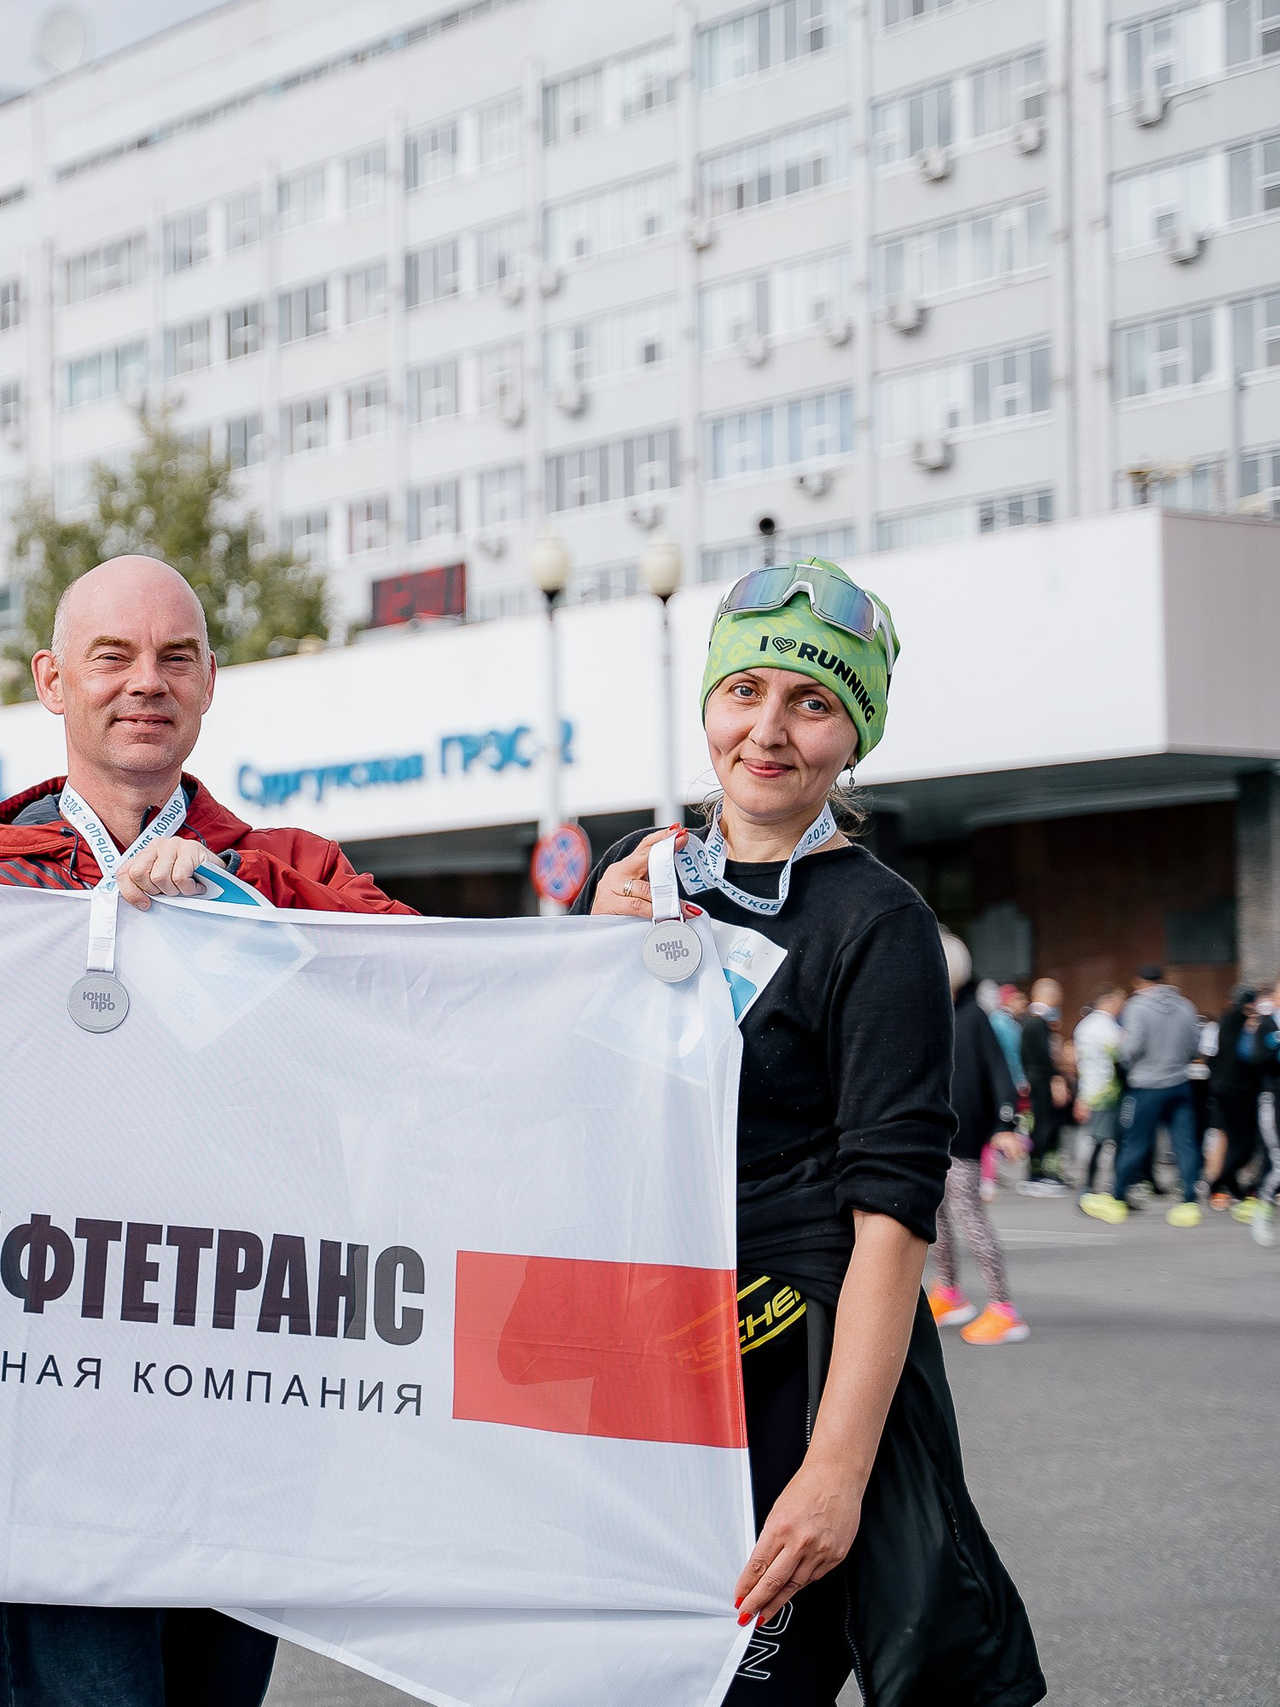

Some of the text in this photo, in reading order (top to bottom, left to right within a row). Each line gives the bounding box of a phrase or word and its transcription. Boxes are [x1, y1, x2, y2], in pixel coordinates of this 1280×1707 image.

[759, 635, 770, 652] I
[797, 643, 876, 724] RUNNING
[63, 795, 82, 815] 2025
[152, 799, 183, 836] КОЛЬЦО
[85, 822, 115, 868] ОЛЬЦО
[806, 818, 831, 845] 2025
[134, 1361, 424, 1416] КОМПАНИЯ
